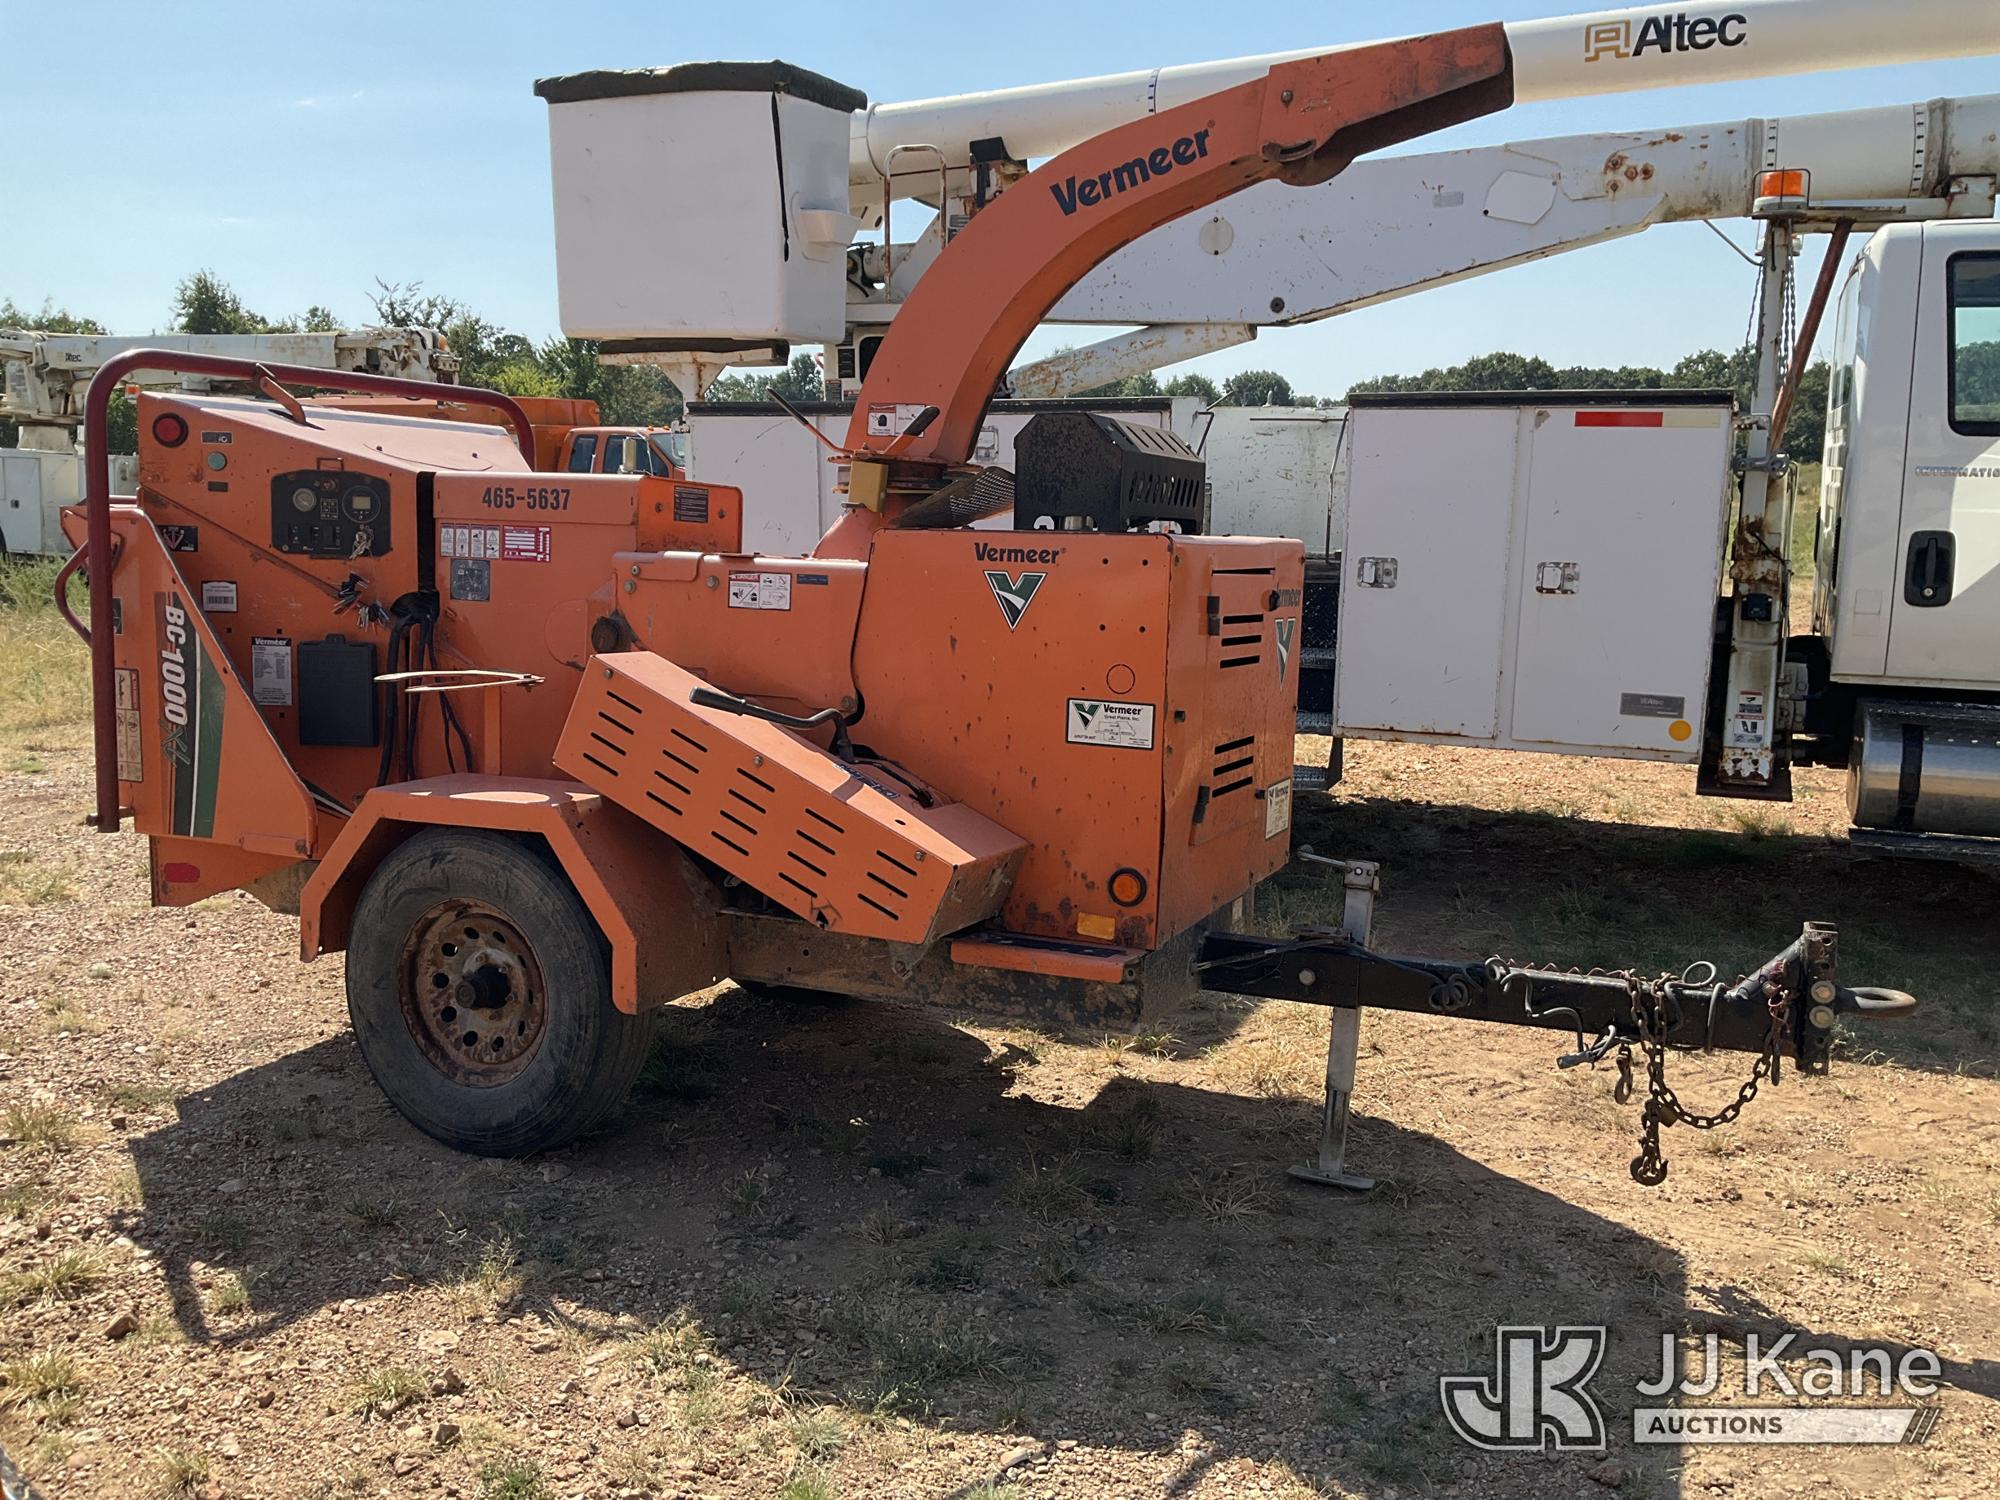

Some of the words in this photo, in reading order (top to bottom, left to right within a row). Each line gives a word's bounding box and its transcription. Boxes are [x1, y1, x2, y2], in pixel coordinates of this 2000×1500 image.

[1632, 13, 1747, 57] Altec
[1049, 128, 1210, 217] Vermeer
[482, 487, 571, 510] 465-5637
[974, 542, 1060, 564] Vermeer
[1103, 703, 1142, 716] Vermeer
